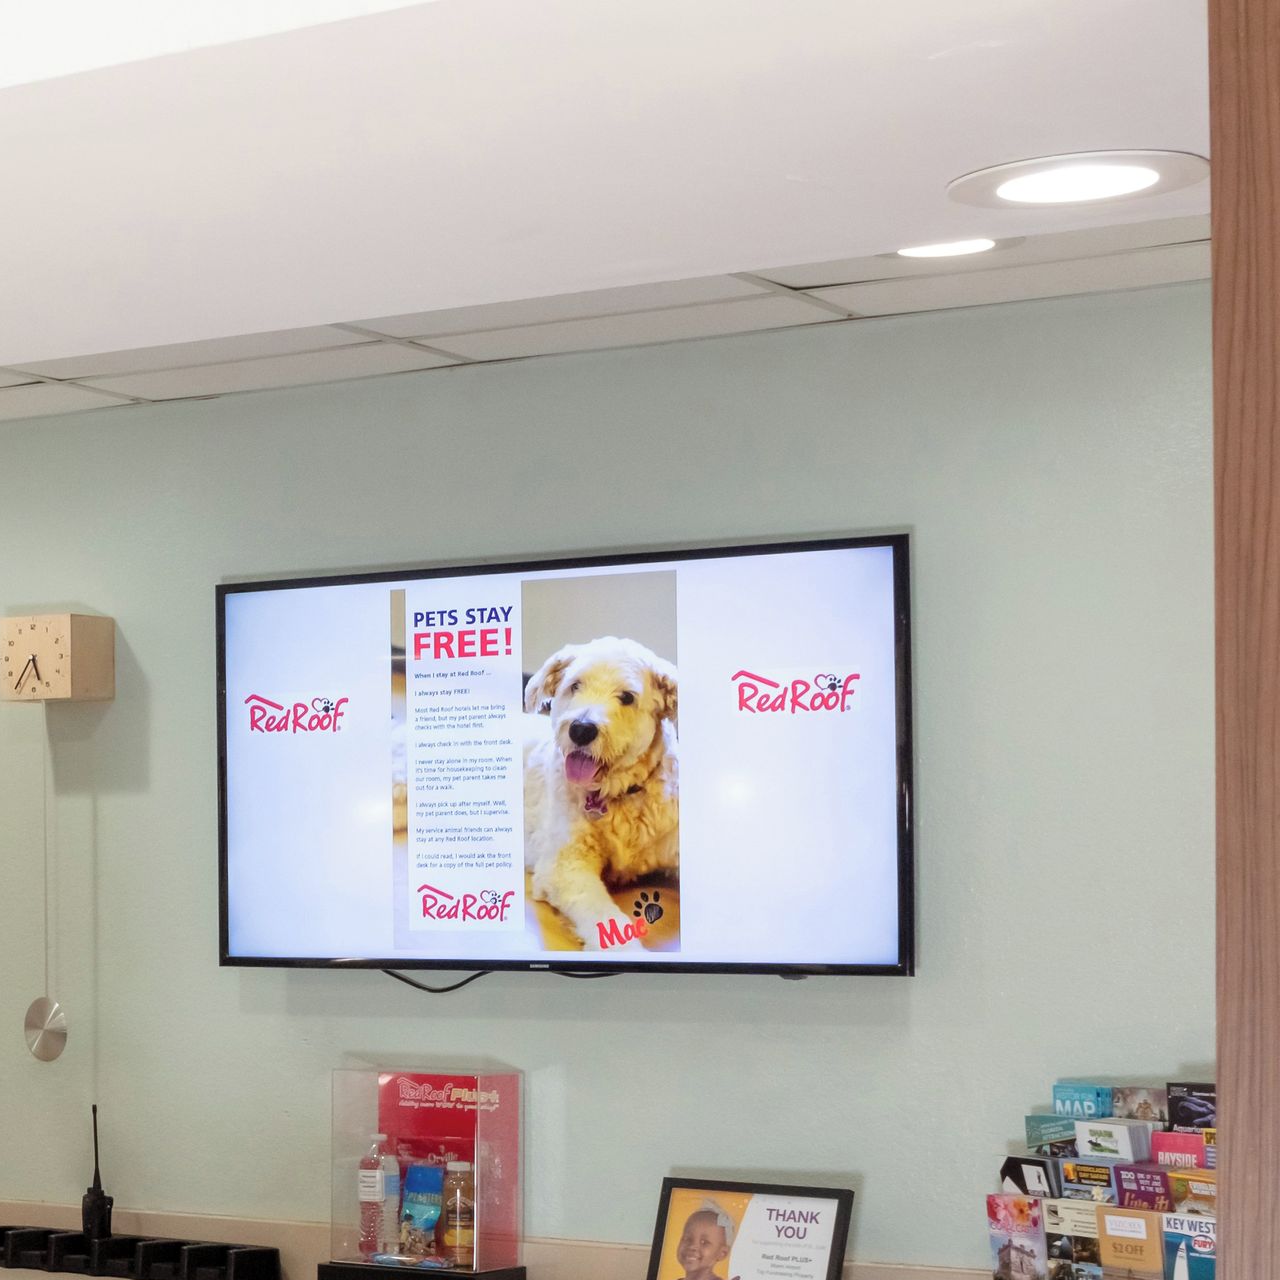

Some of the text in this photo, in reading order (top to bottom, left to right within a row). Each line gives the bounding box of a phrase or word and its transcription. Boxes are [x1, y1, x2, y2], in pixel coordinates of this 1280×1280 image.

[414, 605, 513, 628] PETS STAY
[414, 627, 512, 660] FREE!
[596, 917, 649, 949] Mac
[1056, 1099, 1097, 1116] MAP
[1158, 1151, 1198, 1168] BAYSIDE
[766, 1208, 821, 1225] THANK
[1166, 1216, 1216, 1234] KEY WEST
[775, 1225, 807, 1240] YOU
[1194, 1239, 1213, 1249] FURY
